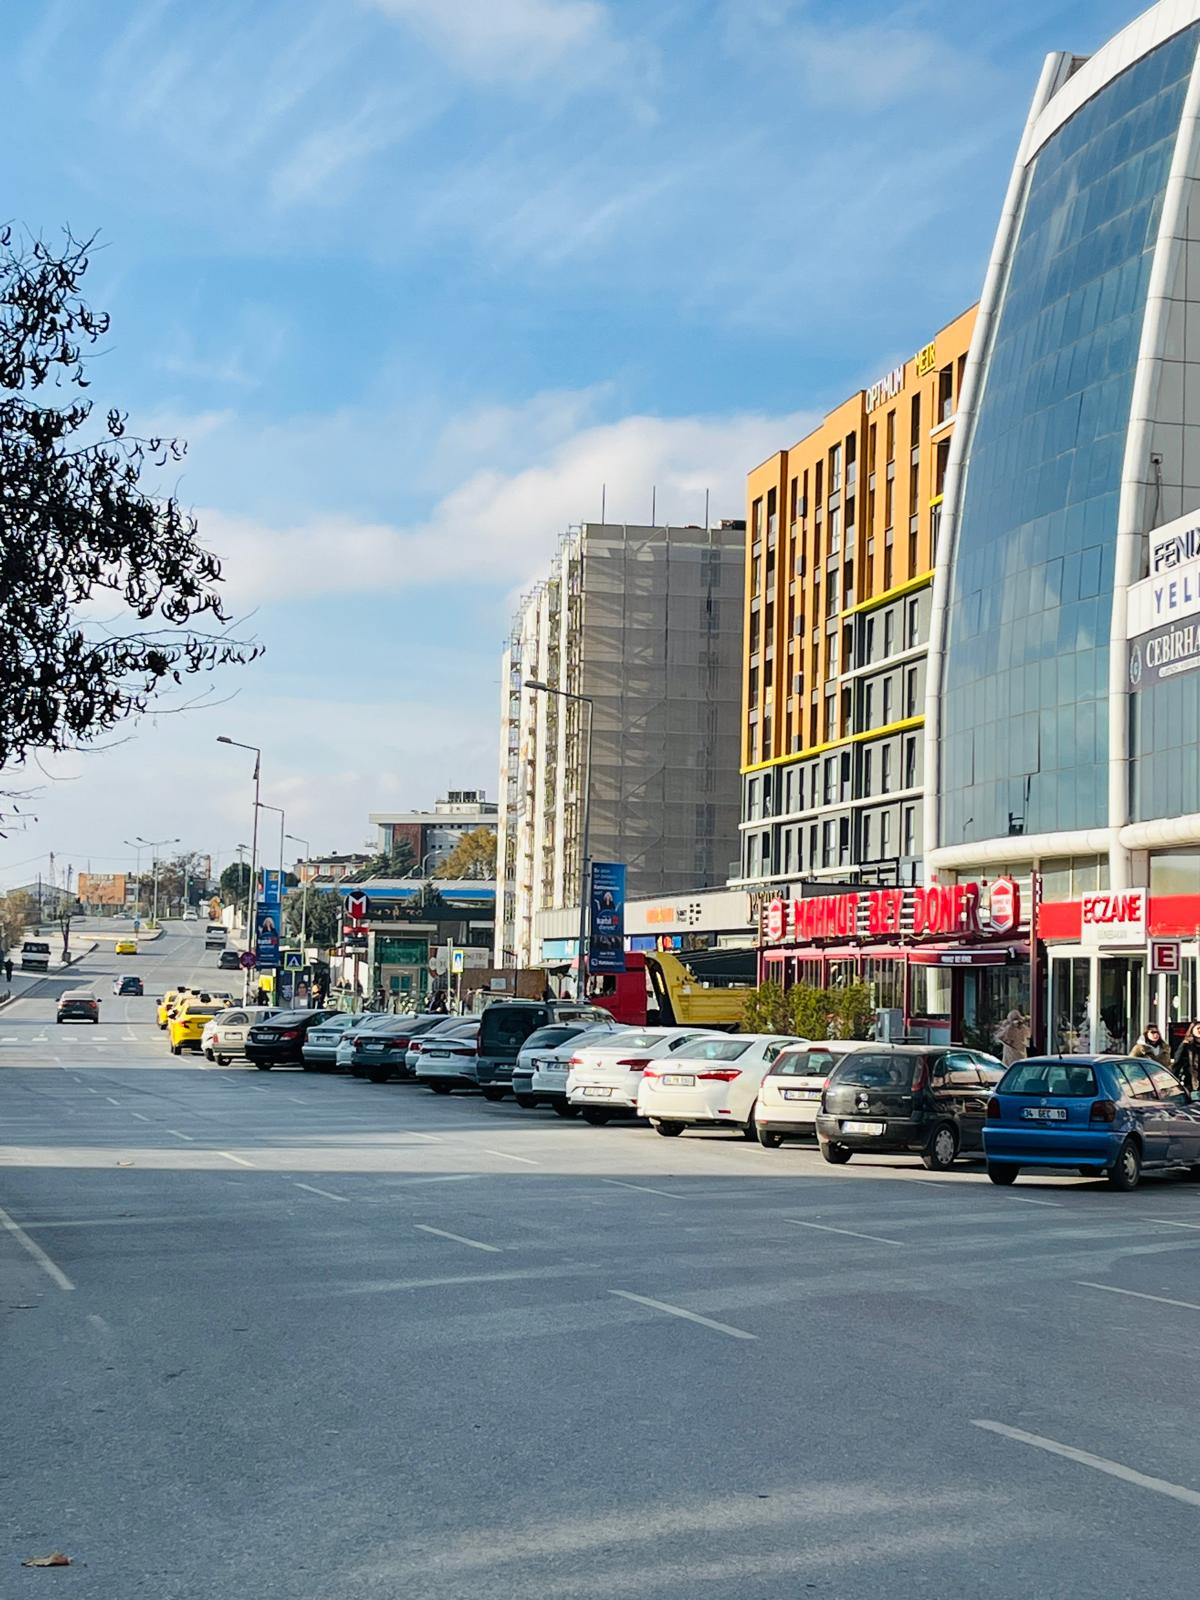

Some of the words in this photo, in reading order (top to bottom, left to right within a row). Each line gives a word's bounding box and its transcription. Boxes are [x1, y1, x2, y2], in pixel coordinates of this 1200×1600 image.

[865, 364, 904, 414] OPTIMUM
[1154, 571, 1200, 614] YEL
[795, 893, 860, 940] MAHMUT
[870, 889, 904, 934] BEY
[1084, 895, 1141, 924] ECZANE
[1158, 946, 1175, 967] E
[1024, 1109, 1033, 1118] 34
